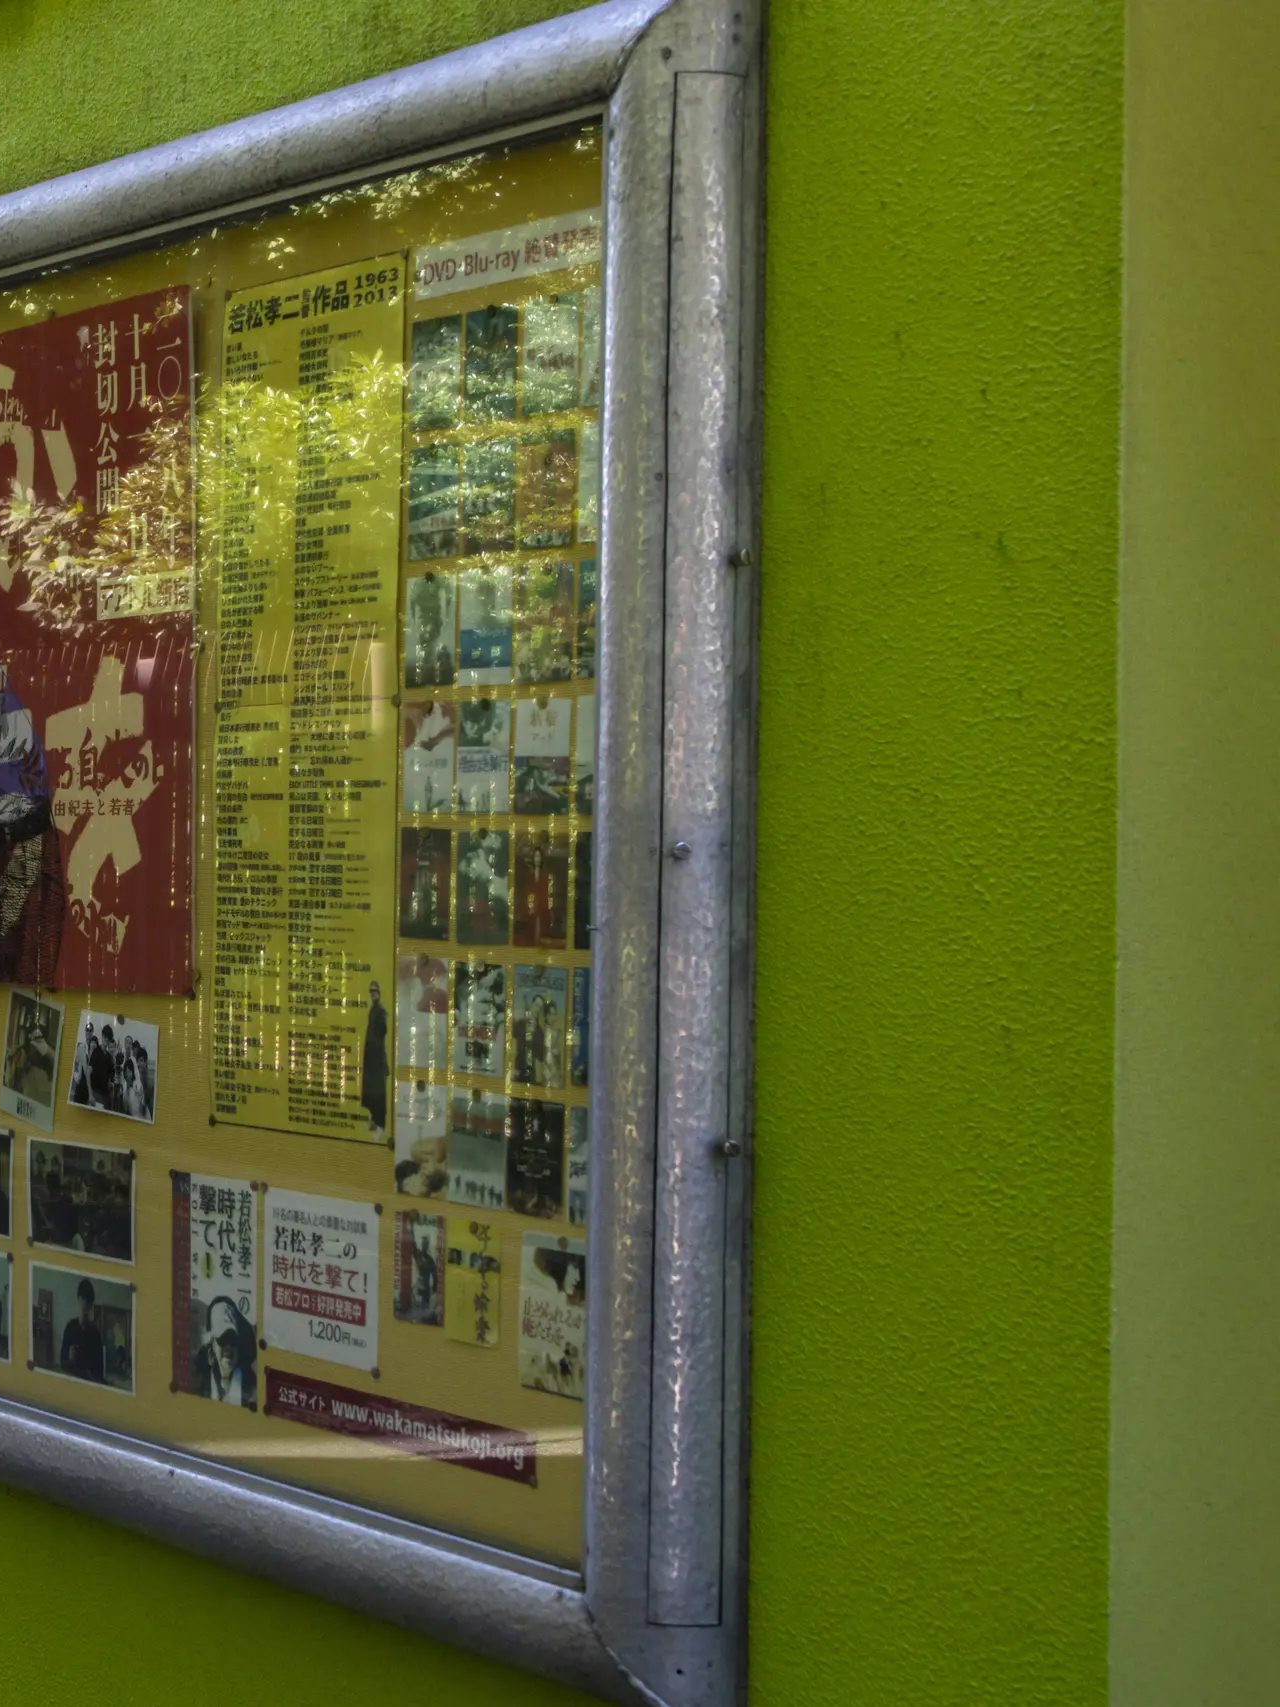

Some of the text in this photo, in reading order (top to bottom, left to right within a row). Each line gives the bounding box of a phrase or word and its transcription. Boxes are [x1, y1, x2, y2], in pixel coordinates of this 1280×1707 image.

[353, 286, 398, 309] 2013
[354, 267, 399, 290] 1963
[94, 320, 120, 516] 封切公開
[217, 1188, 236, 1279] 時代を
[237, 1190, 252, 1316] 若松孝二の
[274, 1225, 358, 1260] 若松孝二の
[272, 1254, 368, 1294] 時代を撃て！
[278, 1385, 525, 1471] 公式サイト www.wakamatsukoji.org
